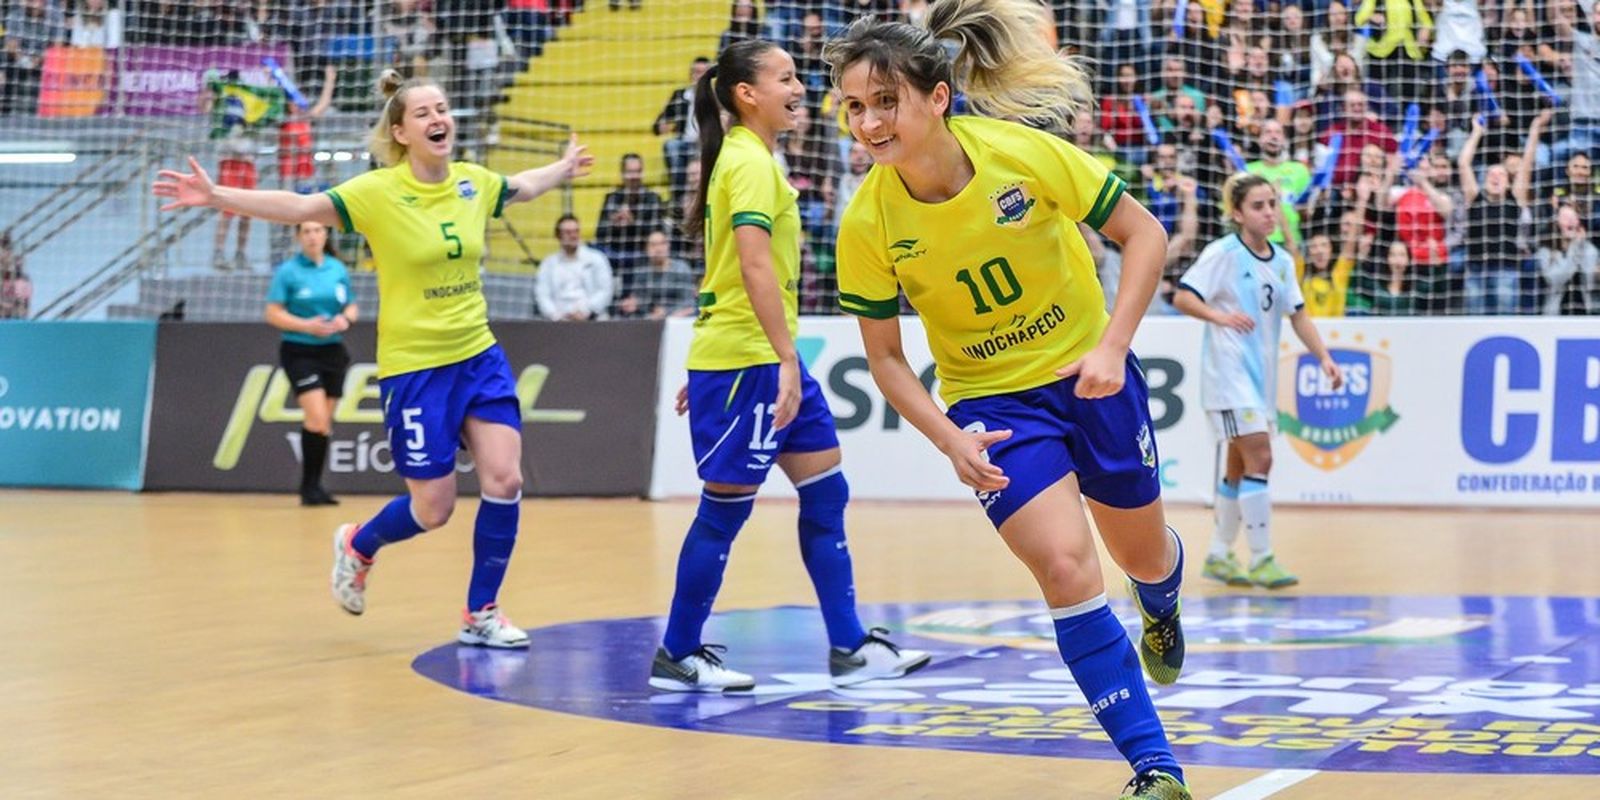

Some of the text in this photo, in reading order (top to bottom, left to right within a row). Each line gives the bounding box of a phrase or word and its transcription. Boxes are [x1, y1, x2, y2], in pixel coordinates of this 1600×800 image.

[440, 222, 462, 260] 5
[955, 257, 1023, 315] 10
[1261, 283, 1274, 312] 3
[402, 407, 425, 450] 5
[748, 402, 778, 450] 12
[1457, 473, 1588, 496] CONFEDERAÇÃO
[1092, 688, 1130, 714] CBFS
[844, 724, 1600, 757] RECNSTRU
